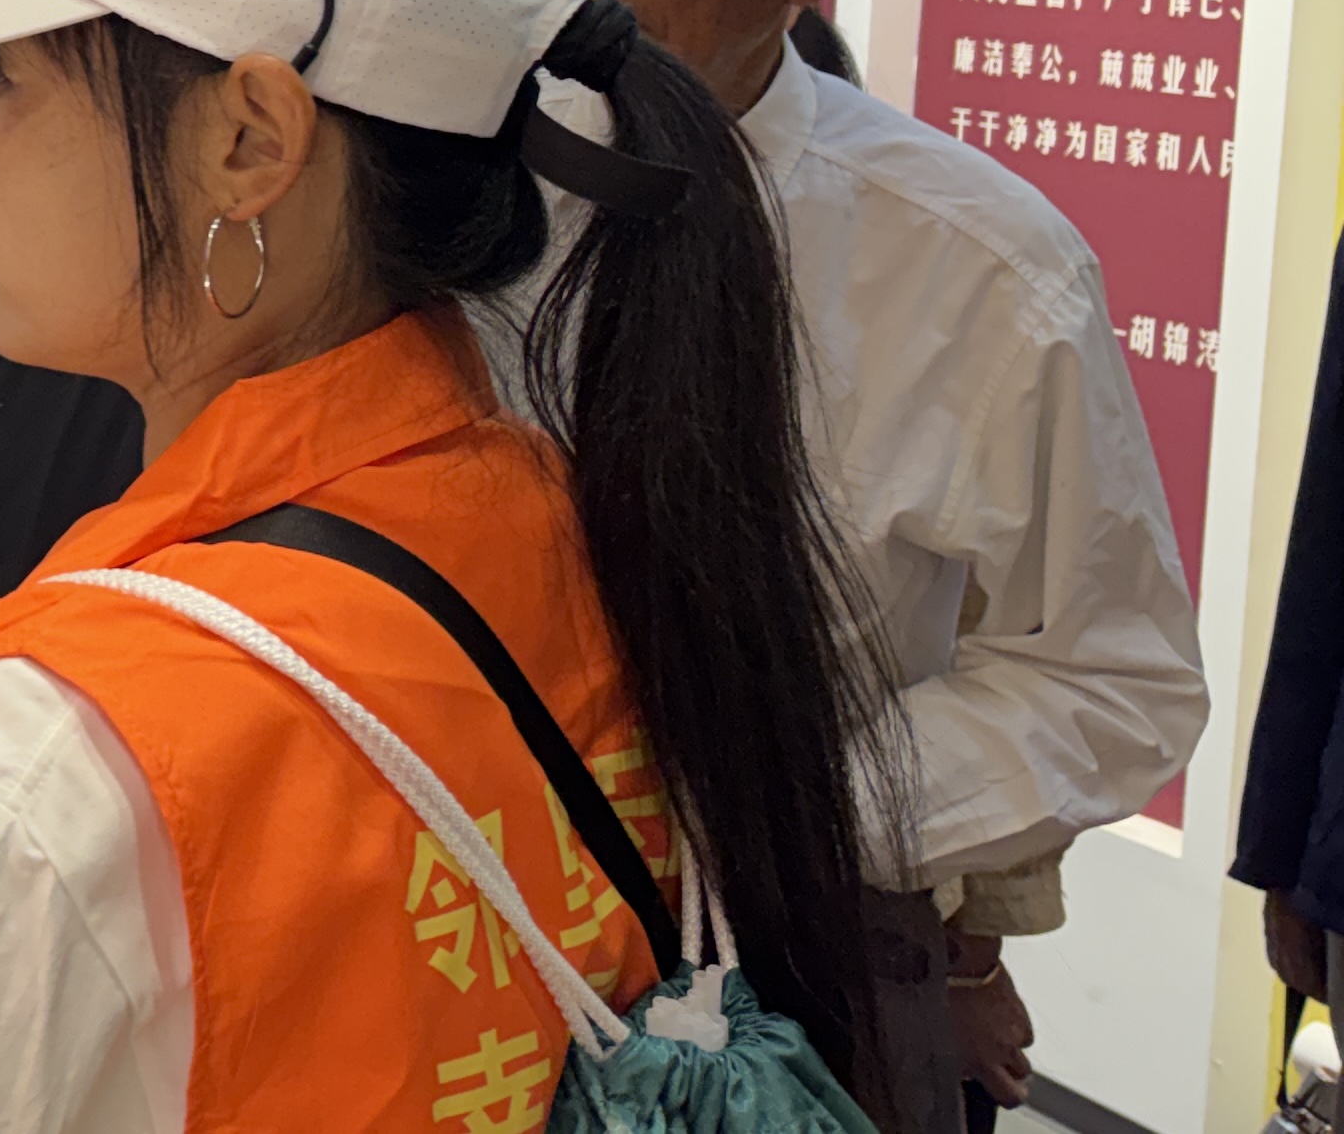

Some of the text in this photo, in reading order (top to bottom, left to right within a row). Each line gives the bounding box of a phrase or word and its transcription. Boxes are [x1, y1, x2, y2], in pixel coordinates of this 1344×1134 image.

[953, 35, 1236, 99] 廉洁奉公，兢兢业业、
